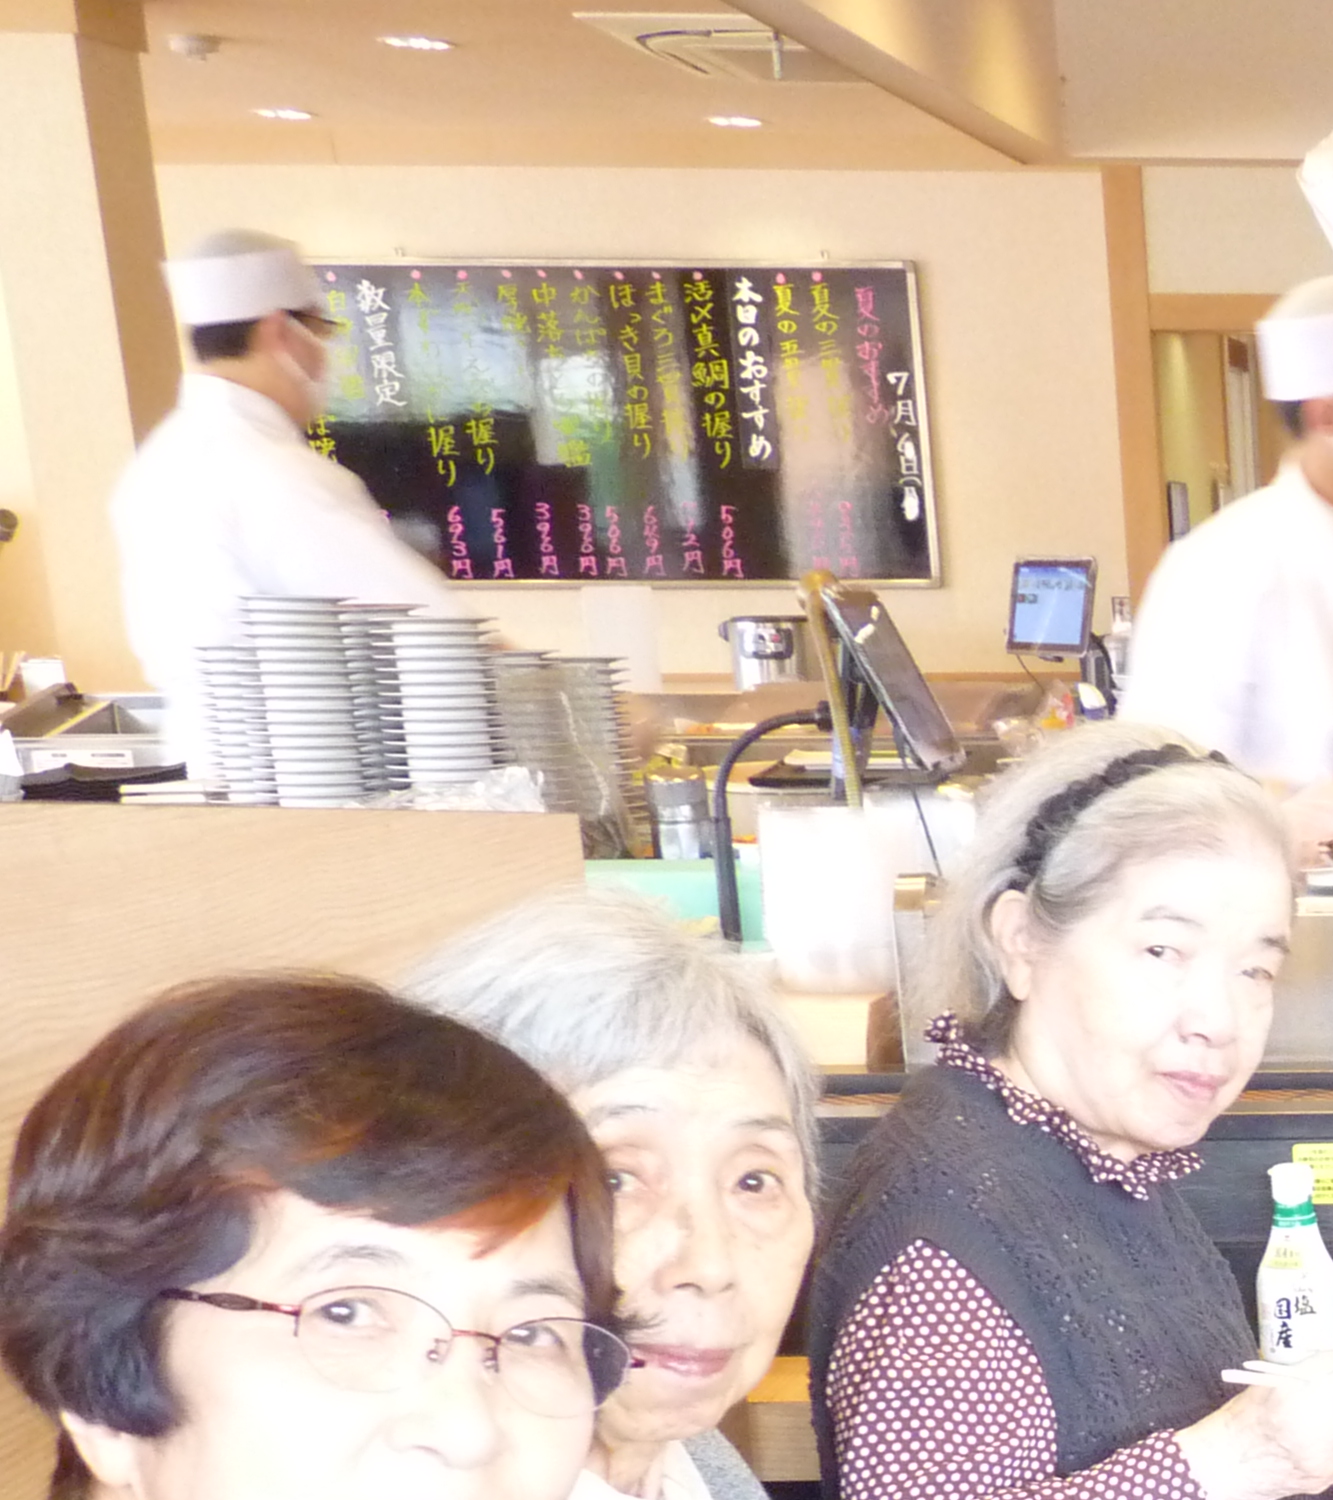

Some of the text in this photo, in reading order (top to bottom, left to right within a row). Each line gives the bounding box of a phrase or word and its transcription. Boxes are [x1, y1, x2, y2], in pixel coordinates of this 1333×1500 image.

[354, 278, 407, 406] 数量限定
[609, 283, 653, 460] ほっき貝の握り
[731, 277, 775, 461] 本日のおすすめ
[535, 502, 559, 575] 396円
[576, 503, 599, 576] 396円
[604, 505, 628, 577] 506円
[720, 505, 744, 578] 506円
[1273, 1297, 1293, 1349] 国産
